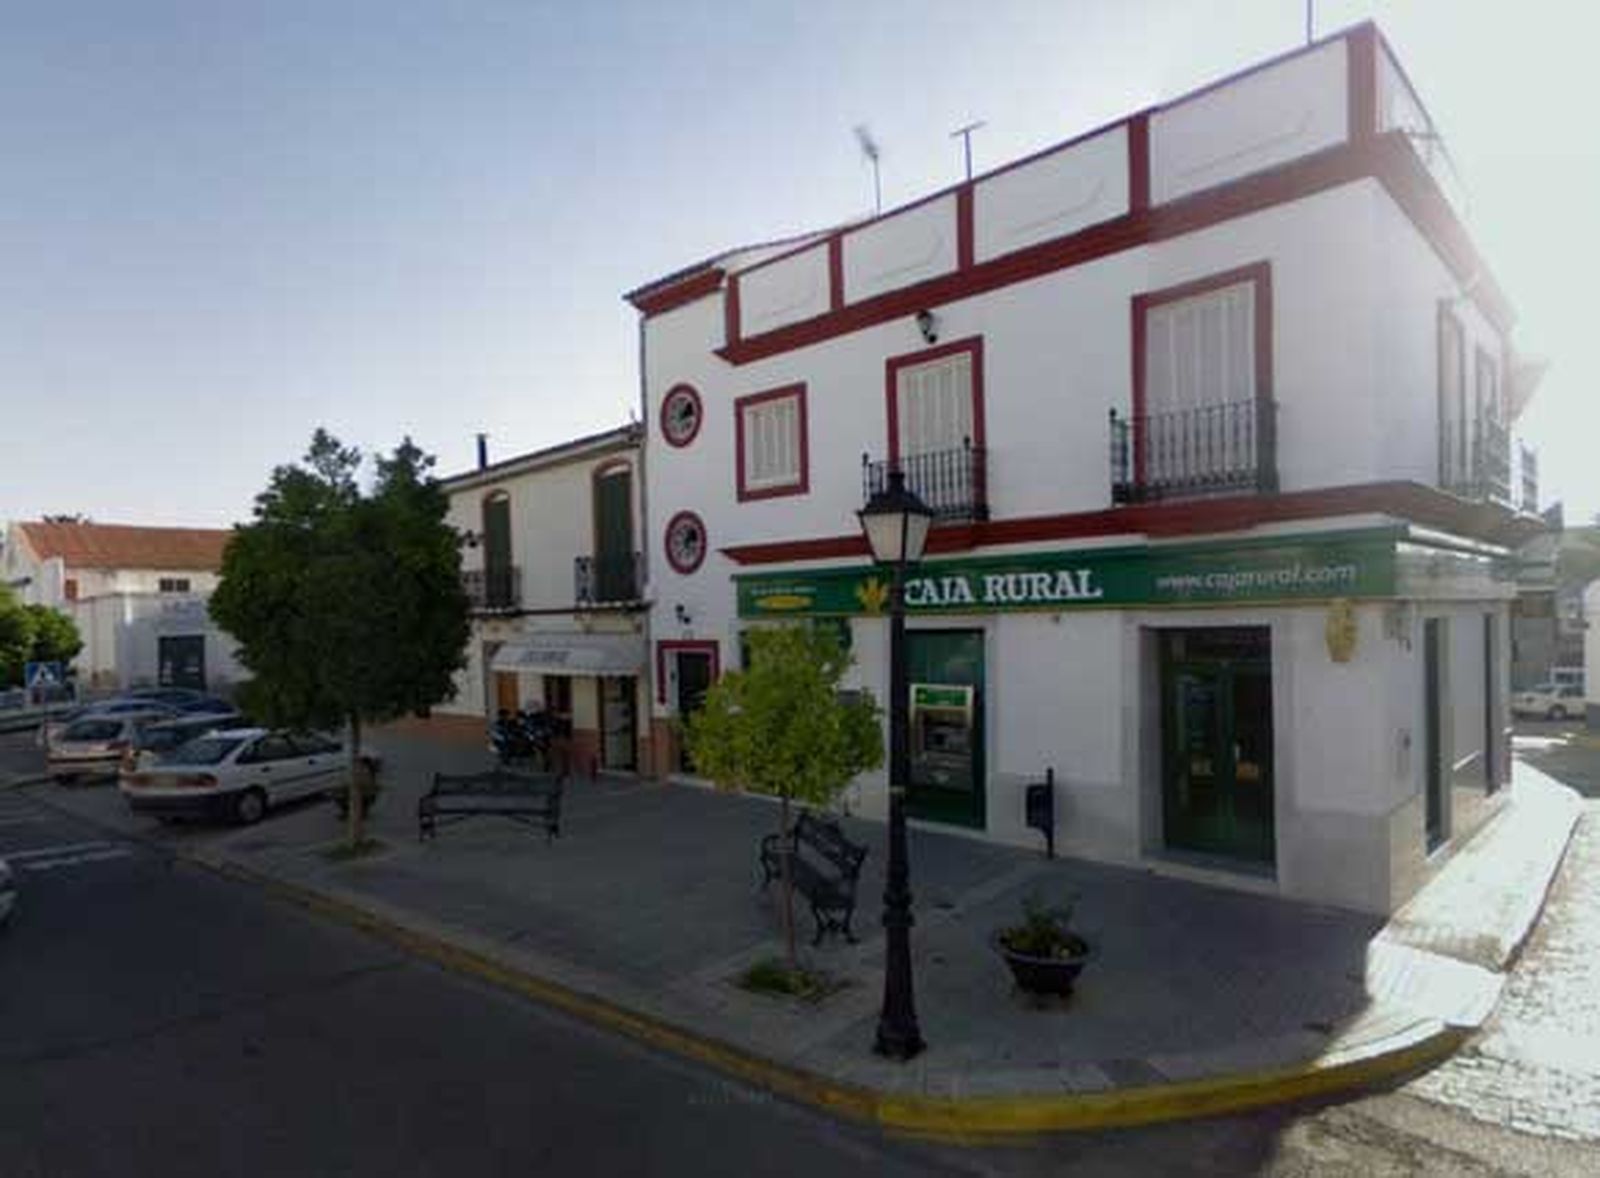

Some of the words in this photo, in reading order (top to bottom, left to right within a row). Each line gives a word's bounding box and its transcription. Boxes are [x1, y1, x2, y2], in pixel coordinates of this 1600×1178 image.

[904, 576, 975, 605] CAJA
[984, 569, 1102, 601] RURAL
[1155, 563, 1356, 595] www.cajarural.com
